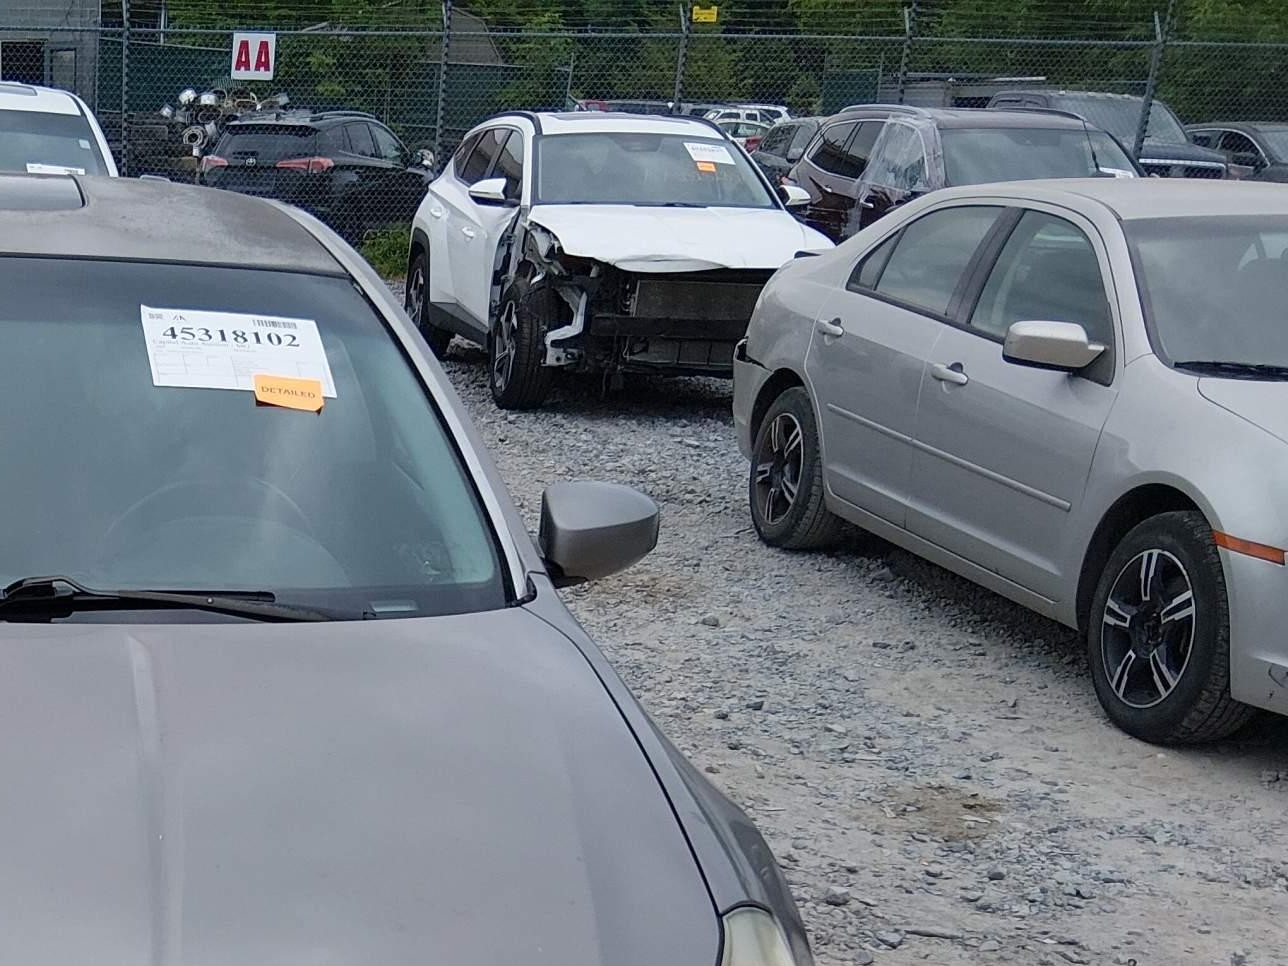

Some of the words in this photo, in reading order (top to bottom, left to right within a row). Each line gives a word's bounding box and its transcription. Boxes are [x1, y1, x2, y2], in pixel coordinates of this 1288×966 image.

[234, 40, 271, 72] AA
[162, 325, 300, 348] 45318102
[261, 385, 316, 399] DETAILED
